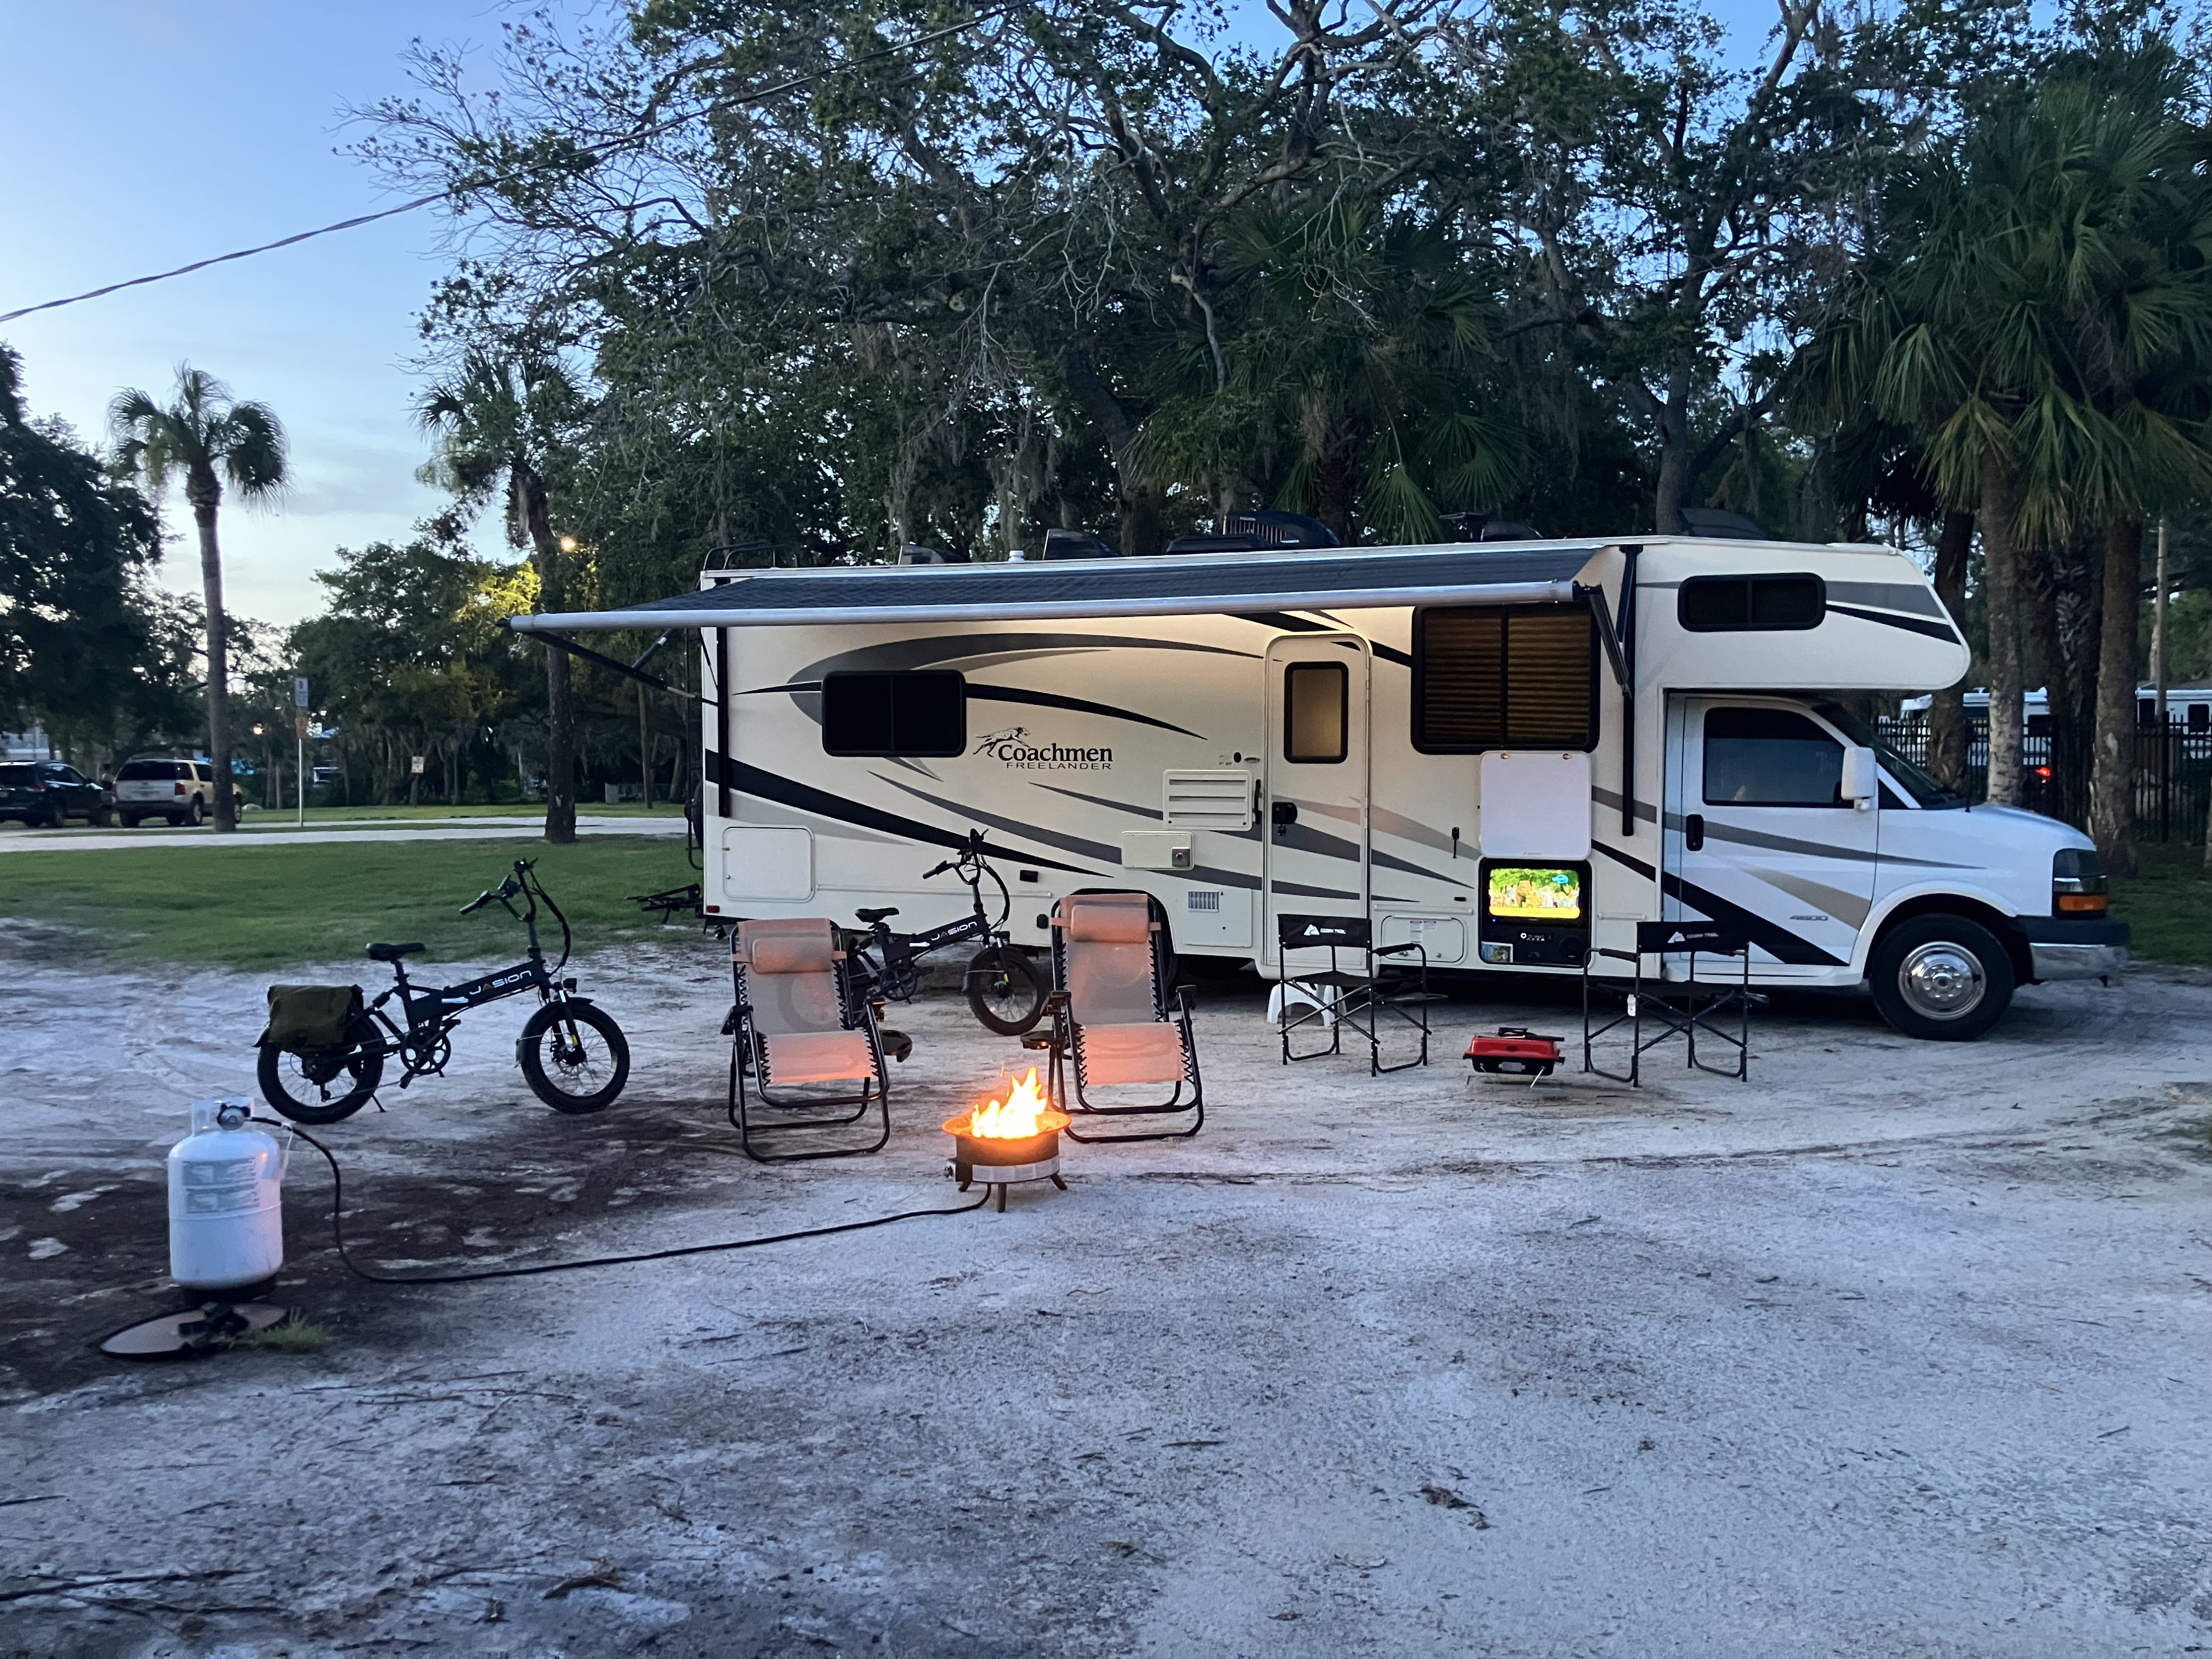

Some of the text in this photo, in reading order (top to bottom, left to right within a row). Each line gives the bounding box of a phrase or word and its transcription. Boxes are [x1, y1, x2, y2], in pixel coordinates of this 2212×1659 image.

[998, 743, 1113, 762] Coachmen
[931, 921, 977, 941] JASION
[469, 970, 532, 995] JASION
